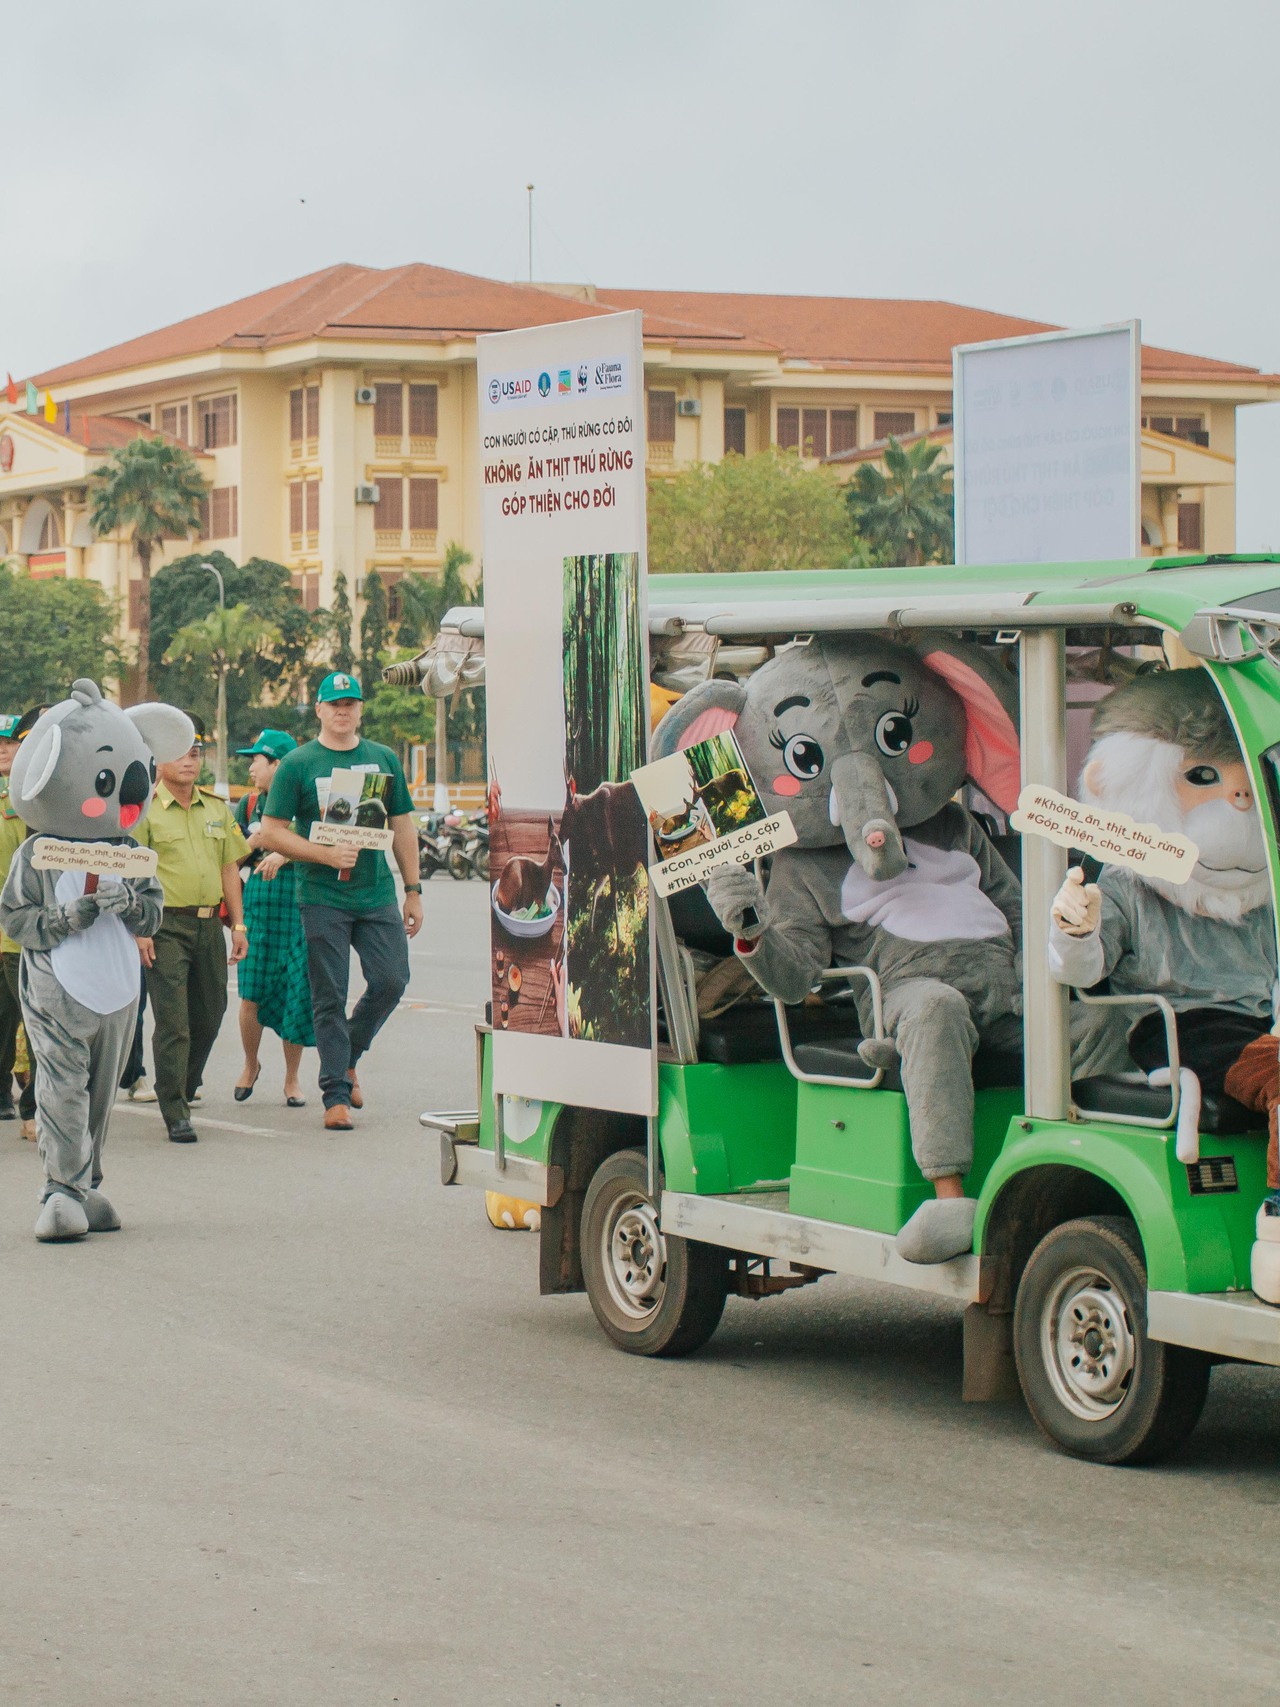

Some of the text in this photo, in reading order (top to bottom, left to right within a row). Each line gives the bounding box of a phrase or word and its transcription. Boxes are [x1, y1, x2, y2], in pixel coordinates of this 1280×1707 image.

[601, 362, 622, 374] Fauna
[604, 373, 622, 384] Flora
[502, 380, 532, 395] USAID
[484, 416, 632, 448] CON NGƯỜI CÓ CẶP, THÚ RỪNG CÓ ĐÔI
[484, 447, 633, 484] KHÔNG ĂN THỊT THÚ RỪNG
[502, 482, 616, 518] GÓP THIỆN CHO ĐỜI
[661, 820, 780, 876] #Con_người_có_cặp
